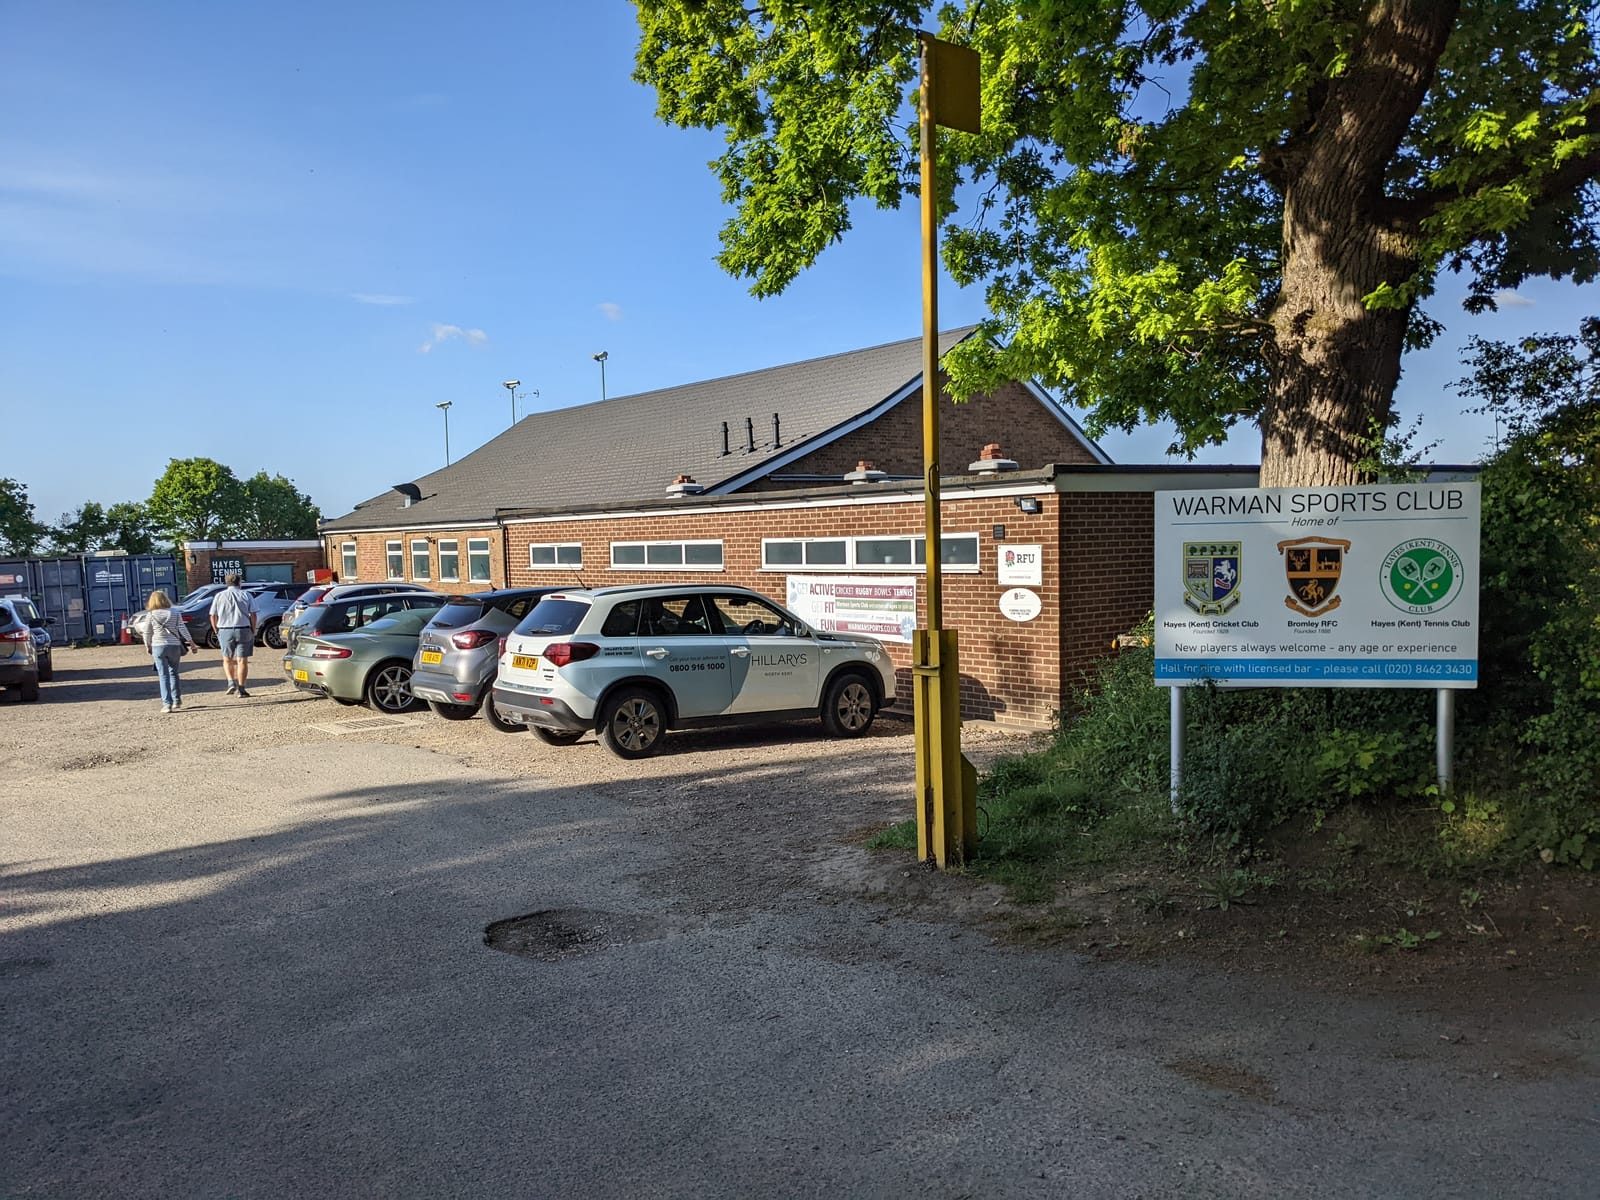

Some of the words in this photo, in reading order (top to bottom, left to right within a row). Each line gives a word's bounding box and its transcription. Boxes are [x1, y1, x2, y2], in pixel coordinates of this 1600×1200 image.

[1172, 494, 1281, 516] WARMAN
[1290, 491, 1387, 514] SPORTS
[1396, 490, 1463, 511] CLUB
[1291, 517, 1325, 527] Home
[1326, 516, 1340, 526] of
[1016, 553, 1035, 564] RFU
[1385, 546, 1406, 569] HAYES
[1405, 540, 1435, 550] (KENT)
[1436, 543, 1460, 568] TENNIS
[212, 560, 240, 568] HAYES
[1401, 560, 1417, 576] H
[1428, 562, 1441, 575] T
[212, 568, 243, 576] TENNIS
[810, 583, 834, 596] ACTIVE
[836, 586, 854, 595] CRICKET
[856, 587, 873, 596] RUGBY
[874, 587, 892, 596] BOWLS
[893, 588, 913, 597] TENNIS
[824, 602, 834, 613] FIT
[1408, 605, 1433, 613] CLUB
[820, 619, 835, 631] FUN
[1163, 620, 1187, 629] Hayes
[1188, 620, 1211, 629] (Kent)
[1212, 620, 1240, 628] Cricket
[1241, 620, 1260, 628] Club
[1287, 620, 1319, 629] Bromley
[1370, 620, 1396, 629] Hayes
[1397, 620, 1421, 628] (Kent)
[1175, 643, 1198, 652] New
[1200, 643, 1238, 656] players
[1240, 643, 1276, 655] always
[1279, 643, 1326, 652] welcome
[1338, 644, 1357, 654] any
[1360, 644, 1379, 654] age
[1382, 644, 1394, 652] or
[1397, 642, 1458, 654] experience
[751, 653, 807, 667] HILLARYS
[669, 664, 690, 672] 0800
[691, 663, 705, 671] 916
[707, 662, 726, 671] 1000
[1160, 663, 1180, 673] Hall
[1223, 663, 1246, 673] with
[1248, 663, 1291, 673] licensed
[1294, 663, 1312, 673] bar
[1323, 664, 1359, 675] please
[1361, 664, 1381, 674] call
[1384, 663, 1413, 675] (020)
[1415, 664, 1442, 674] 8462
[1446, 664, 1473, 674] 3430
